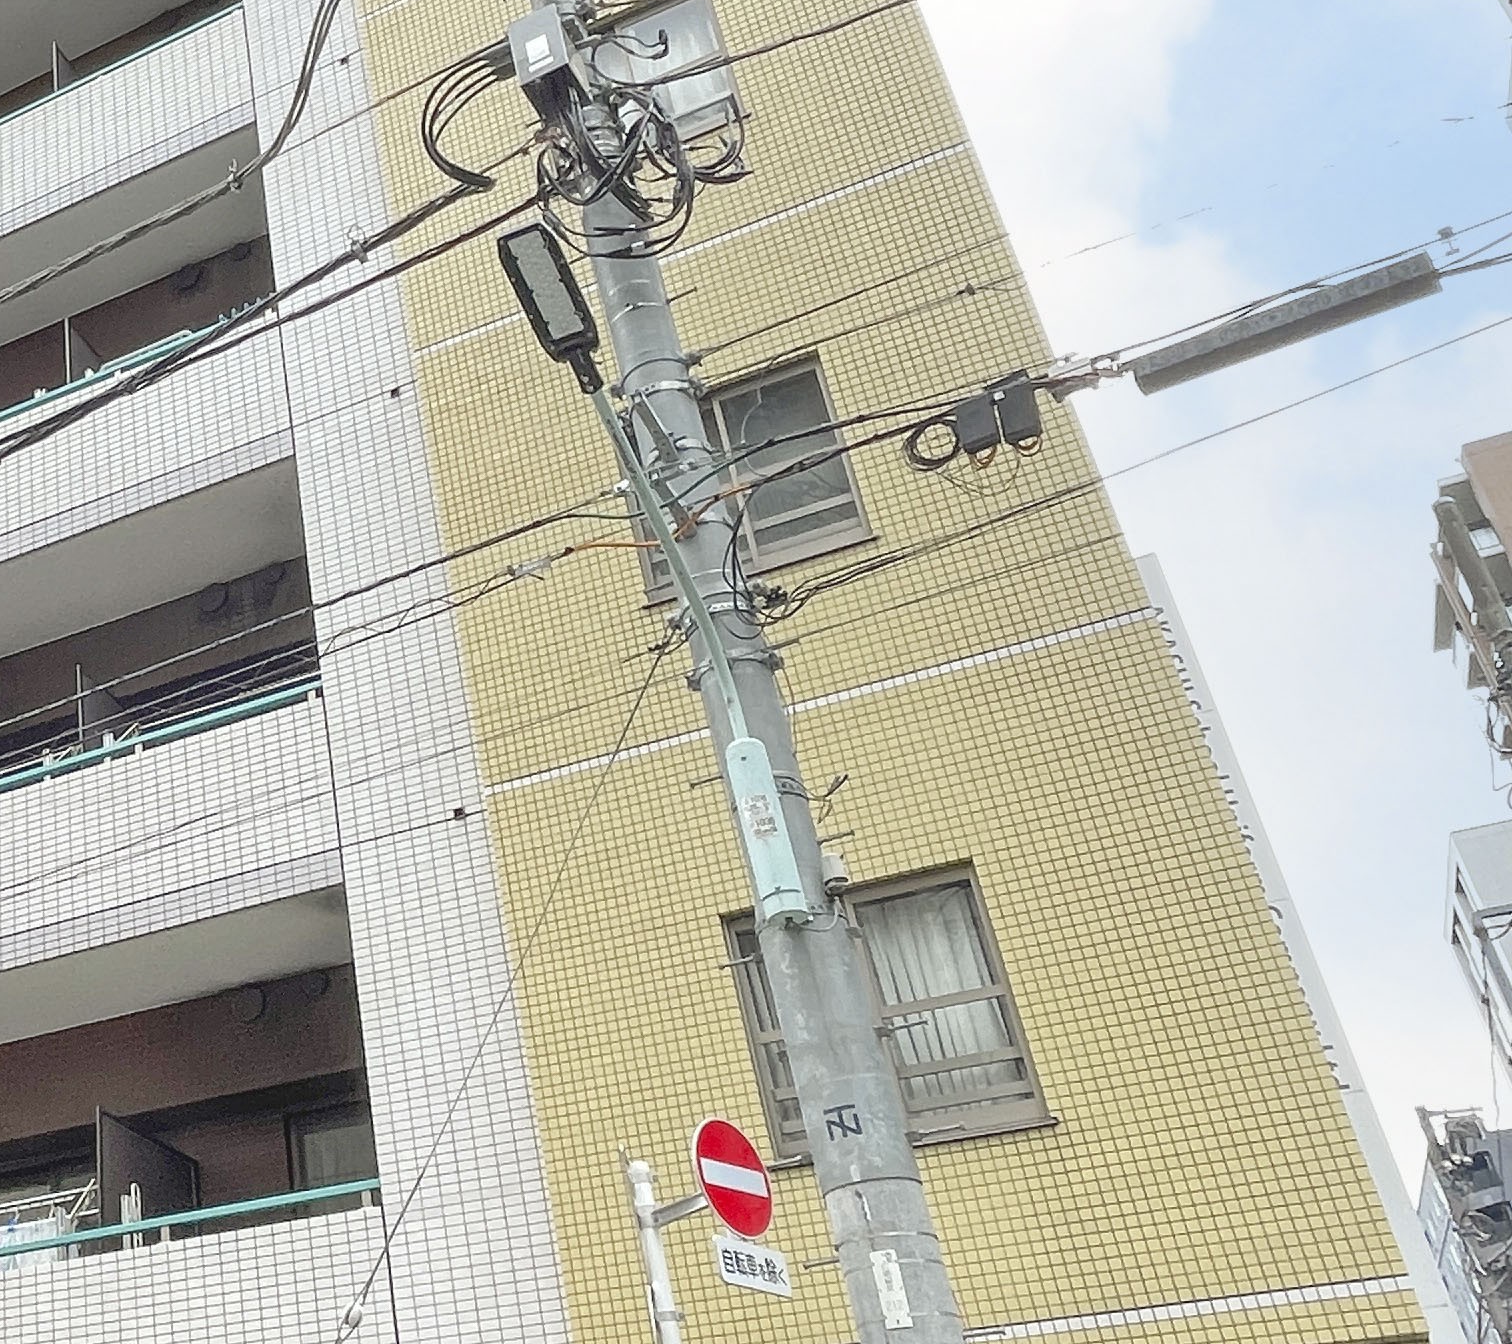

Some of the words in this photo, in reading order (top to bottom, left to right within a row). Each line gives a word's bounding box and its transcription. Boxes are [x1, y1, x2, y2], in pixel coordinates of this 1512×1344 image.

[721, 1248, 788, 1286] 自転車を除く
